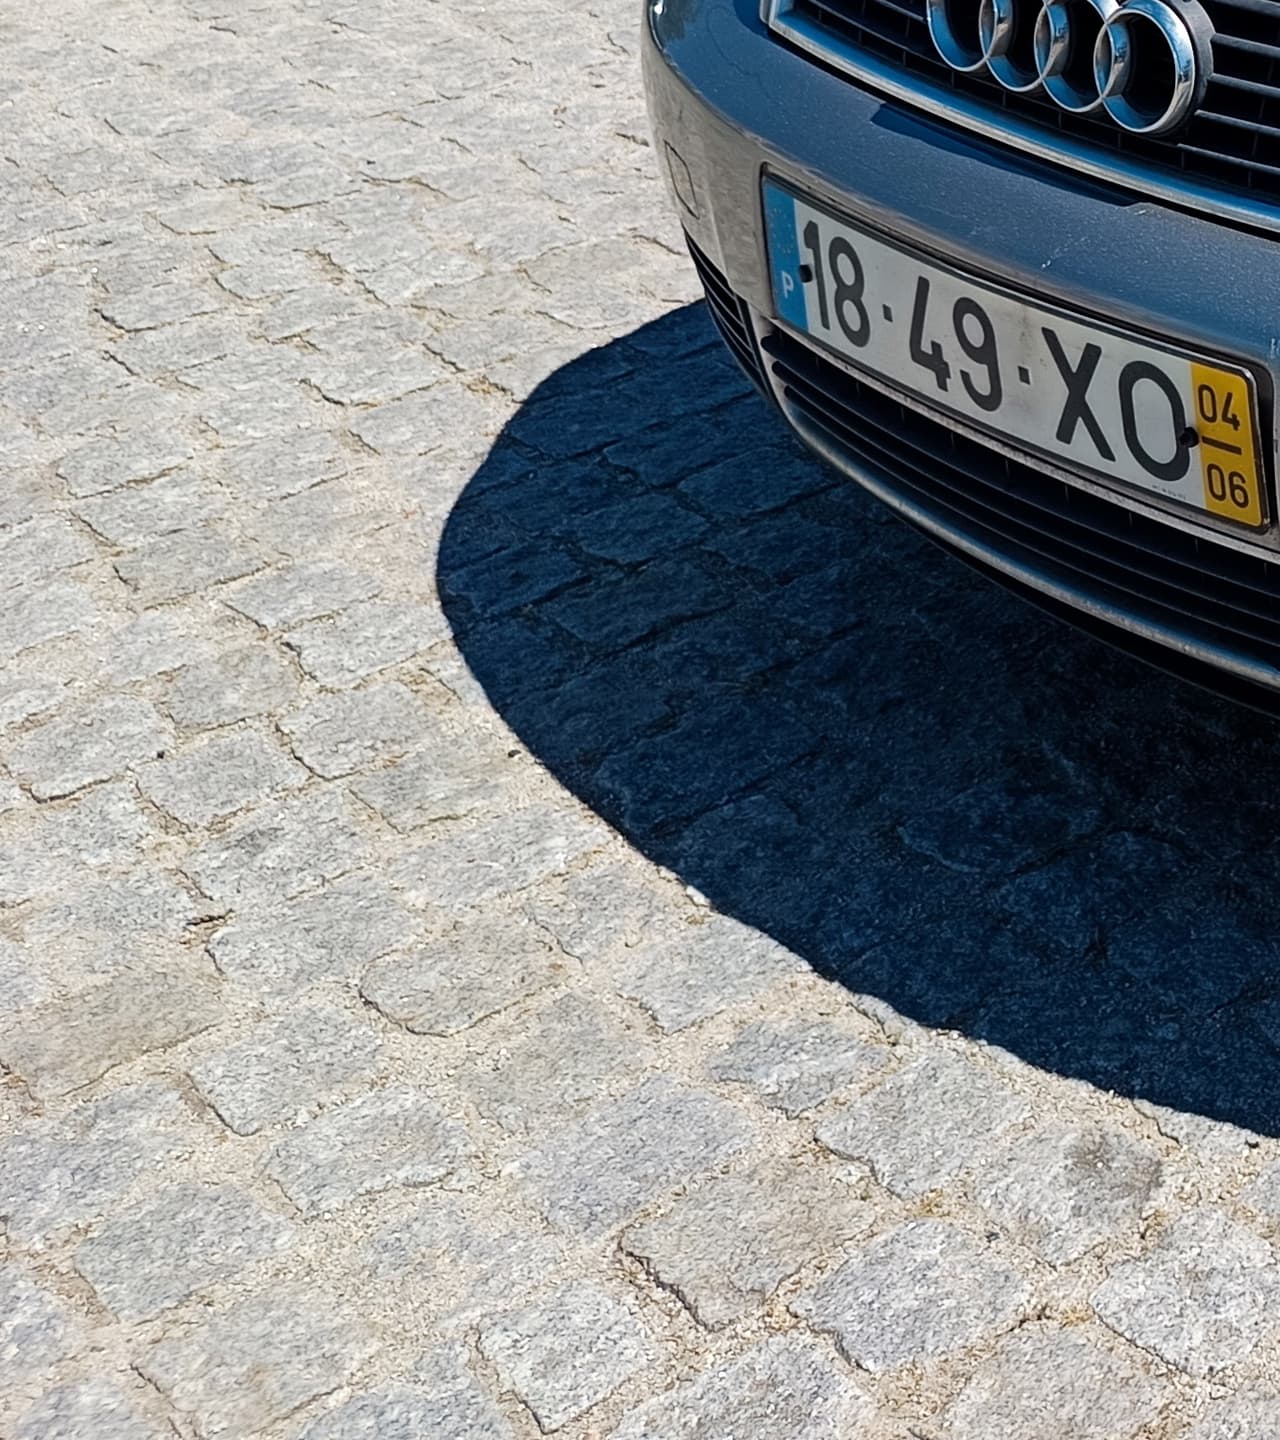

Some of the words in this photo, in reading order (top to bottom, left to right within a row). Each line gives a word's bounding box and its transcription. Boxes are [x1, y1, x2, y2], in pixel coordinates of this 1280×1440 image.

[780, 270, 795, 299] P
[1198, 384, 1241, 432] 04
[1207, 463, 1250, 509] 06
